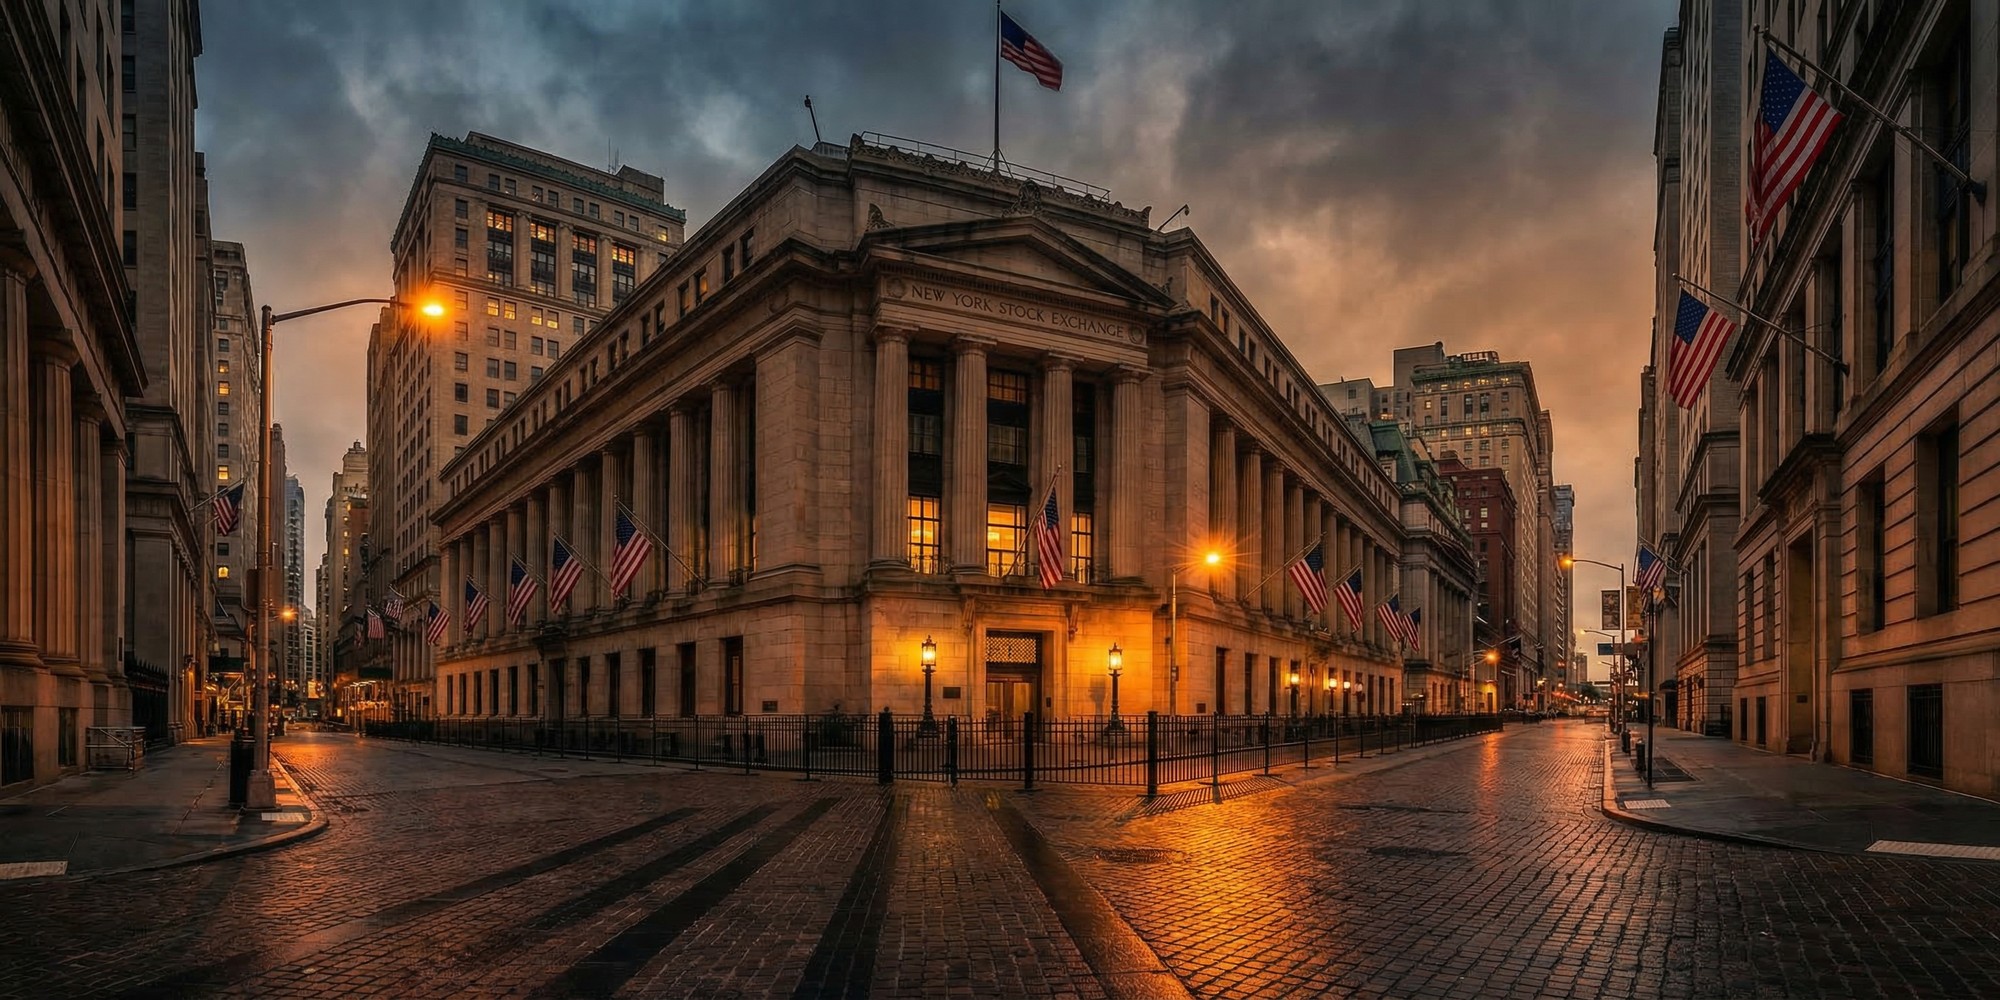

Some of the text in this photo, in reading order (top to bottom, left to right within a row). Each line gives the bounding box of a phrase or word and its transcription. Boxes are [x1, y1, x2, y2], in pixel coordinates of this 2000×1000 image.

[912, 285, 1123, 338] NEW YORK STOCK EXCHANGE
